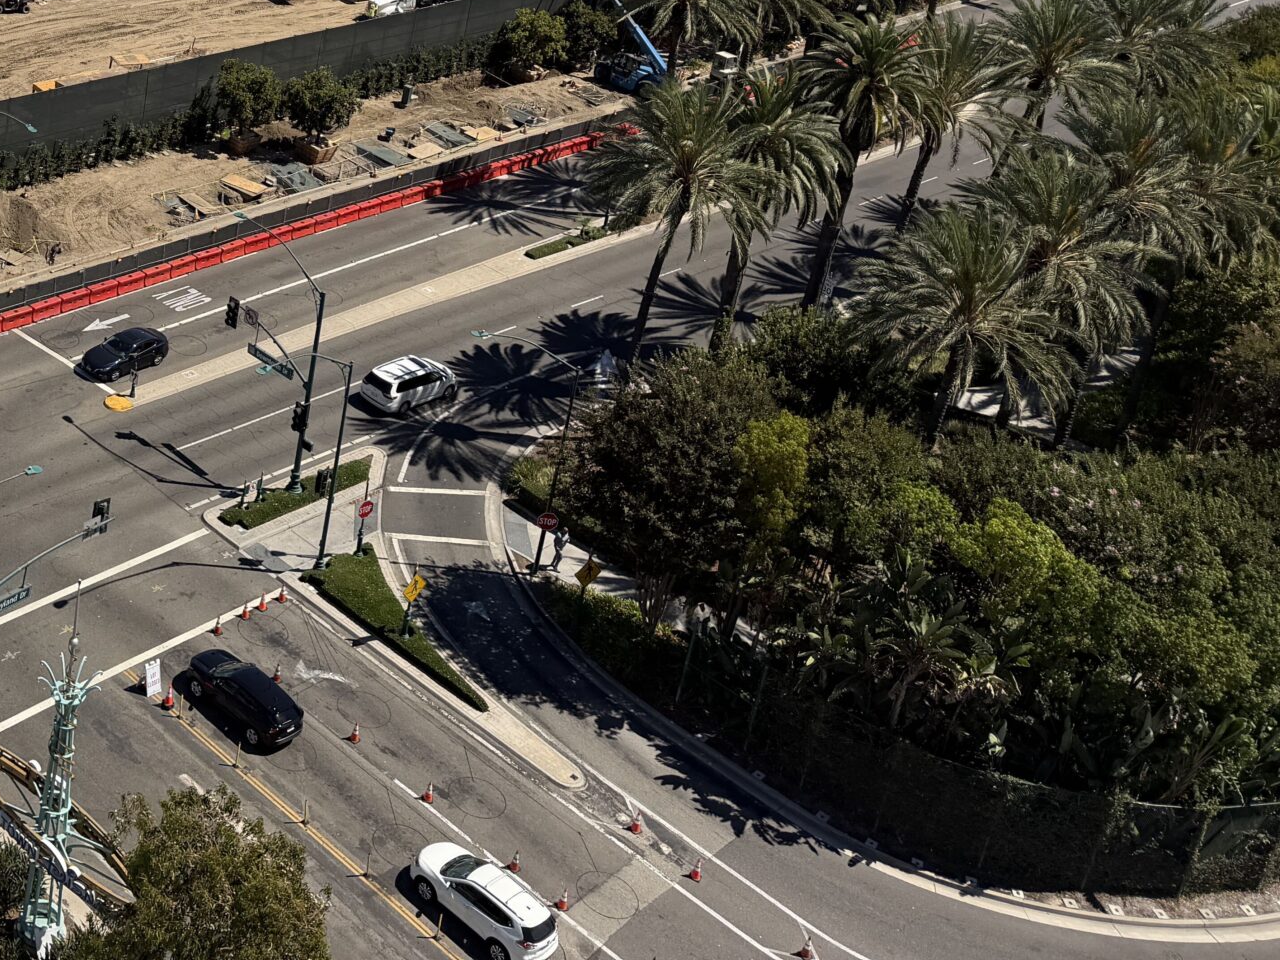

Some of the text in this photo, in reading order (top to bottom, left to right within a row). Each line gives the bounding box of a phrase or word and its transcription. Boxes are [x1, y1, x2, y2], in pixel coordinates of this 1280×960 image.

[151, 285, 212, 312] ONLY
[360, 504, 372, 515] STOP
[538, 517, 557, 526] STOP
[20, 591, 27, 599] Dr
